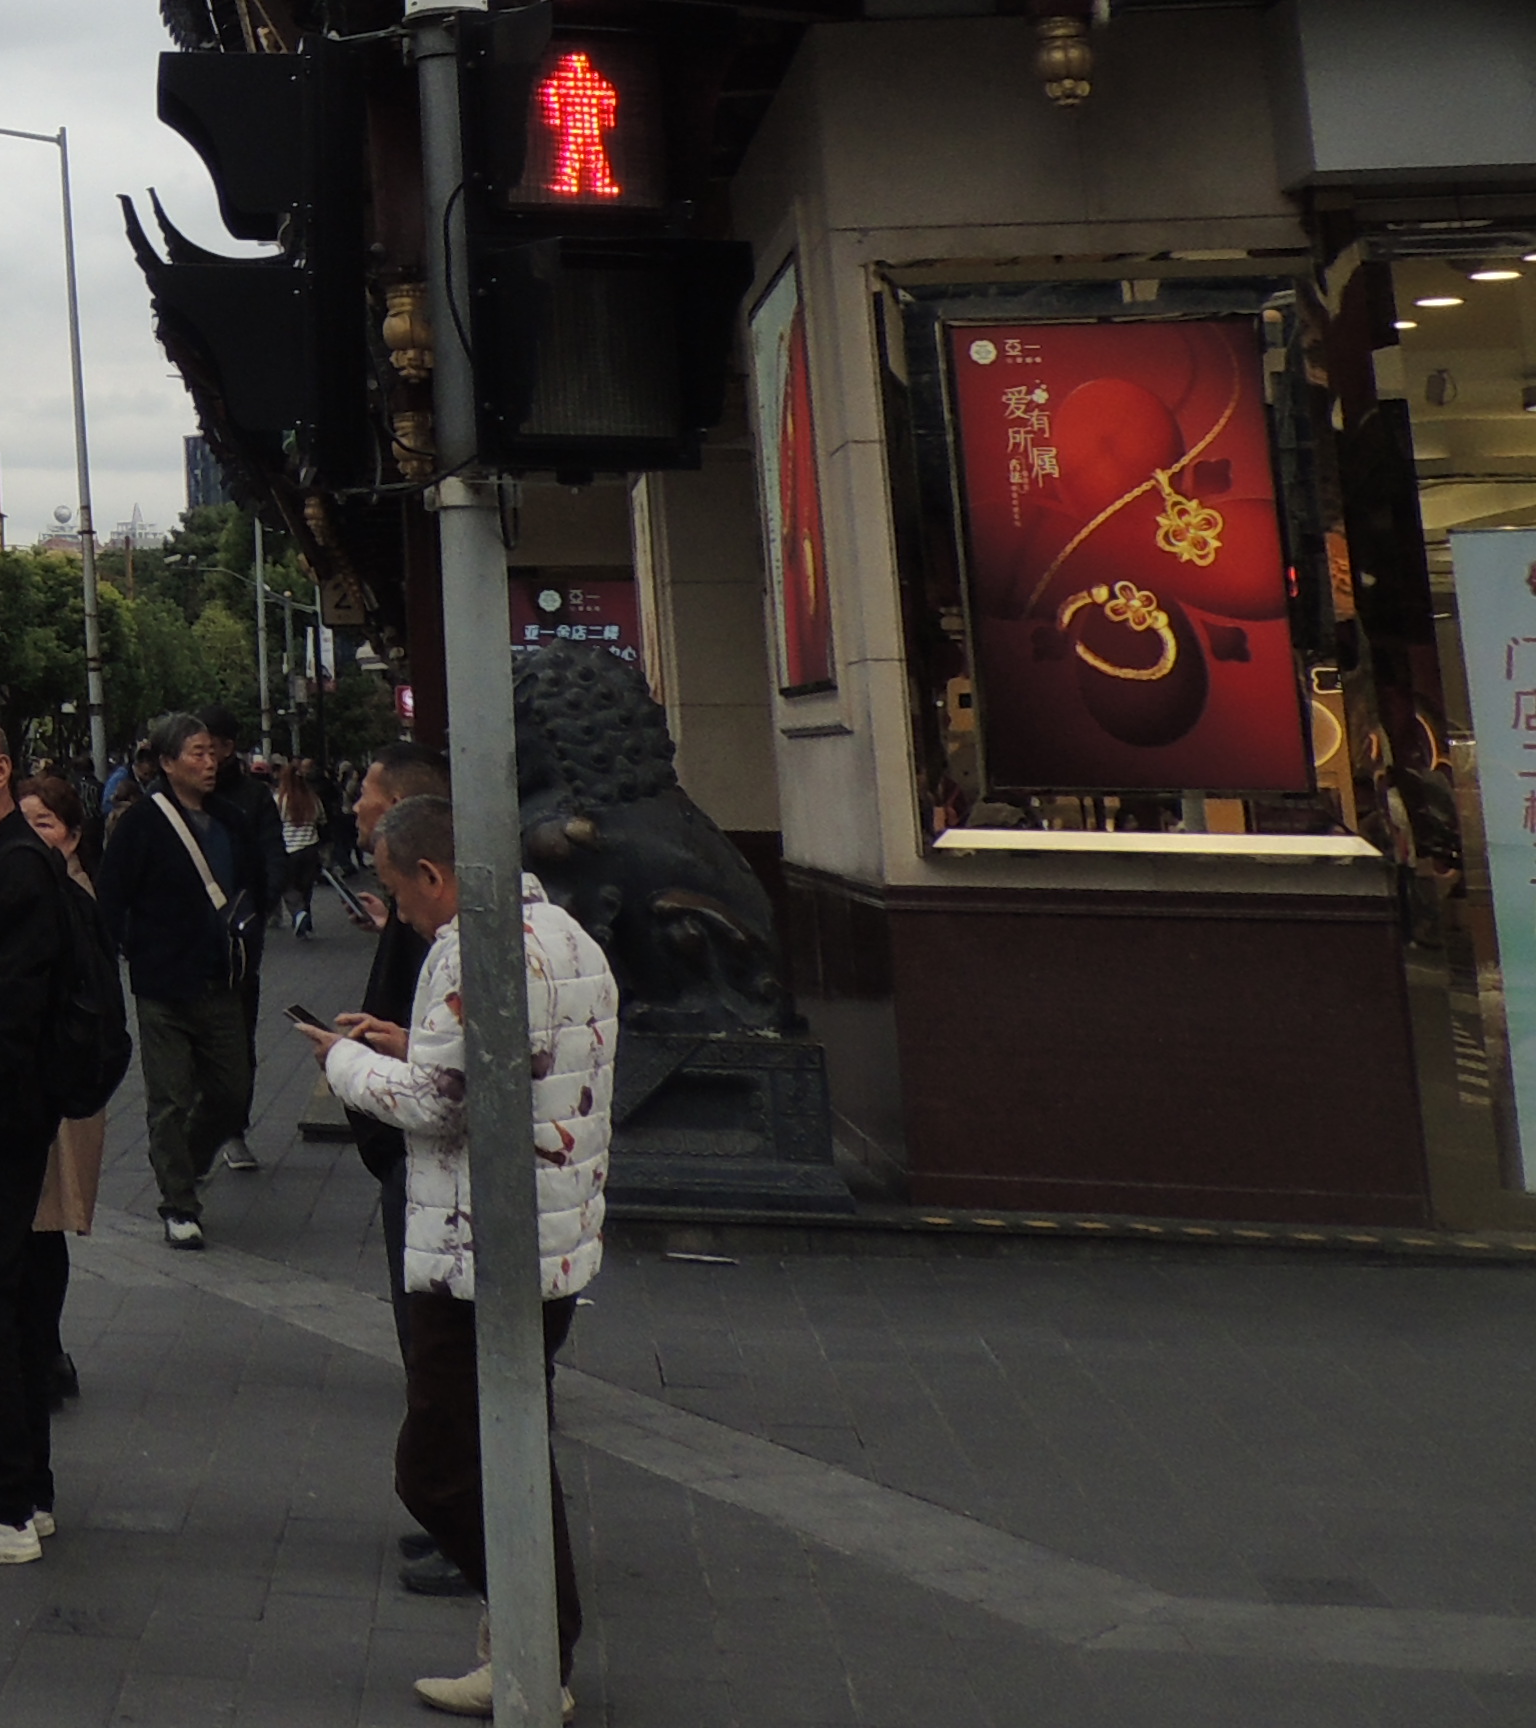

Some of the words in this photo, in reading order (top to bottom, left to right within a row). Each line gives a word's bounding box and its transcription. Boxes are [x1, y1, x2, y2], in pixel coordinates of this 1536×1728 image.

[523, 624, 620, 641] 亚一金店二楼
